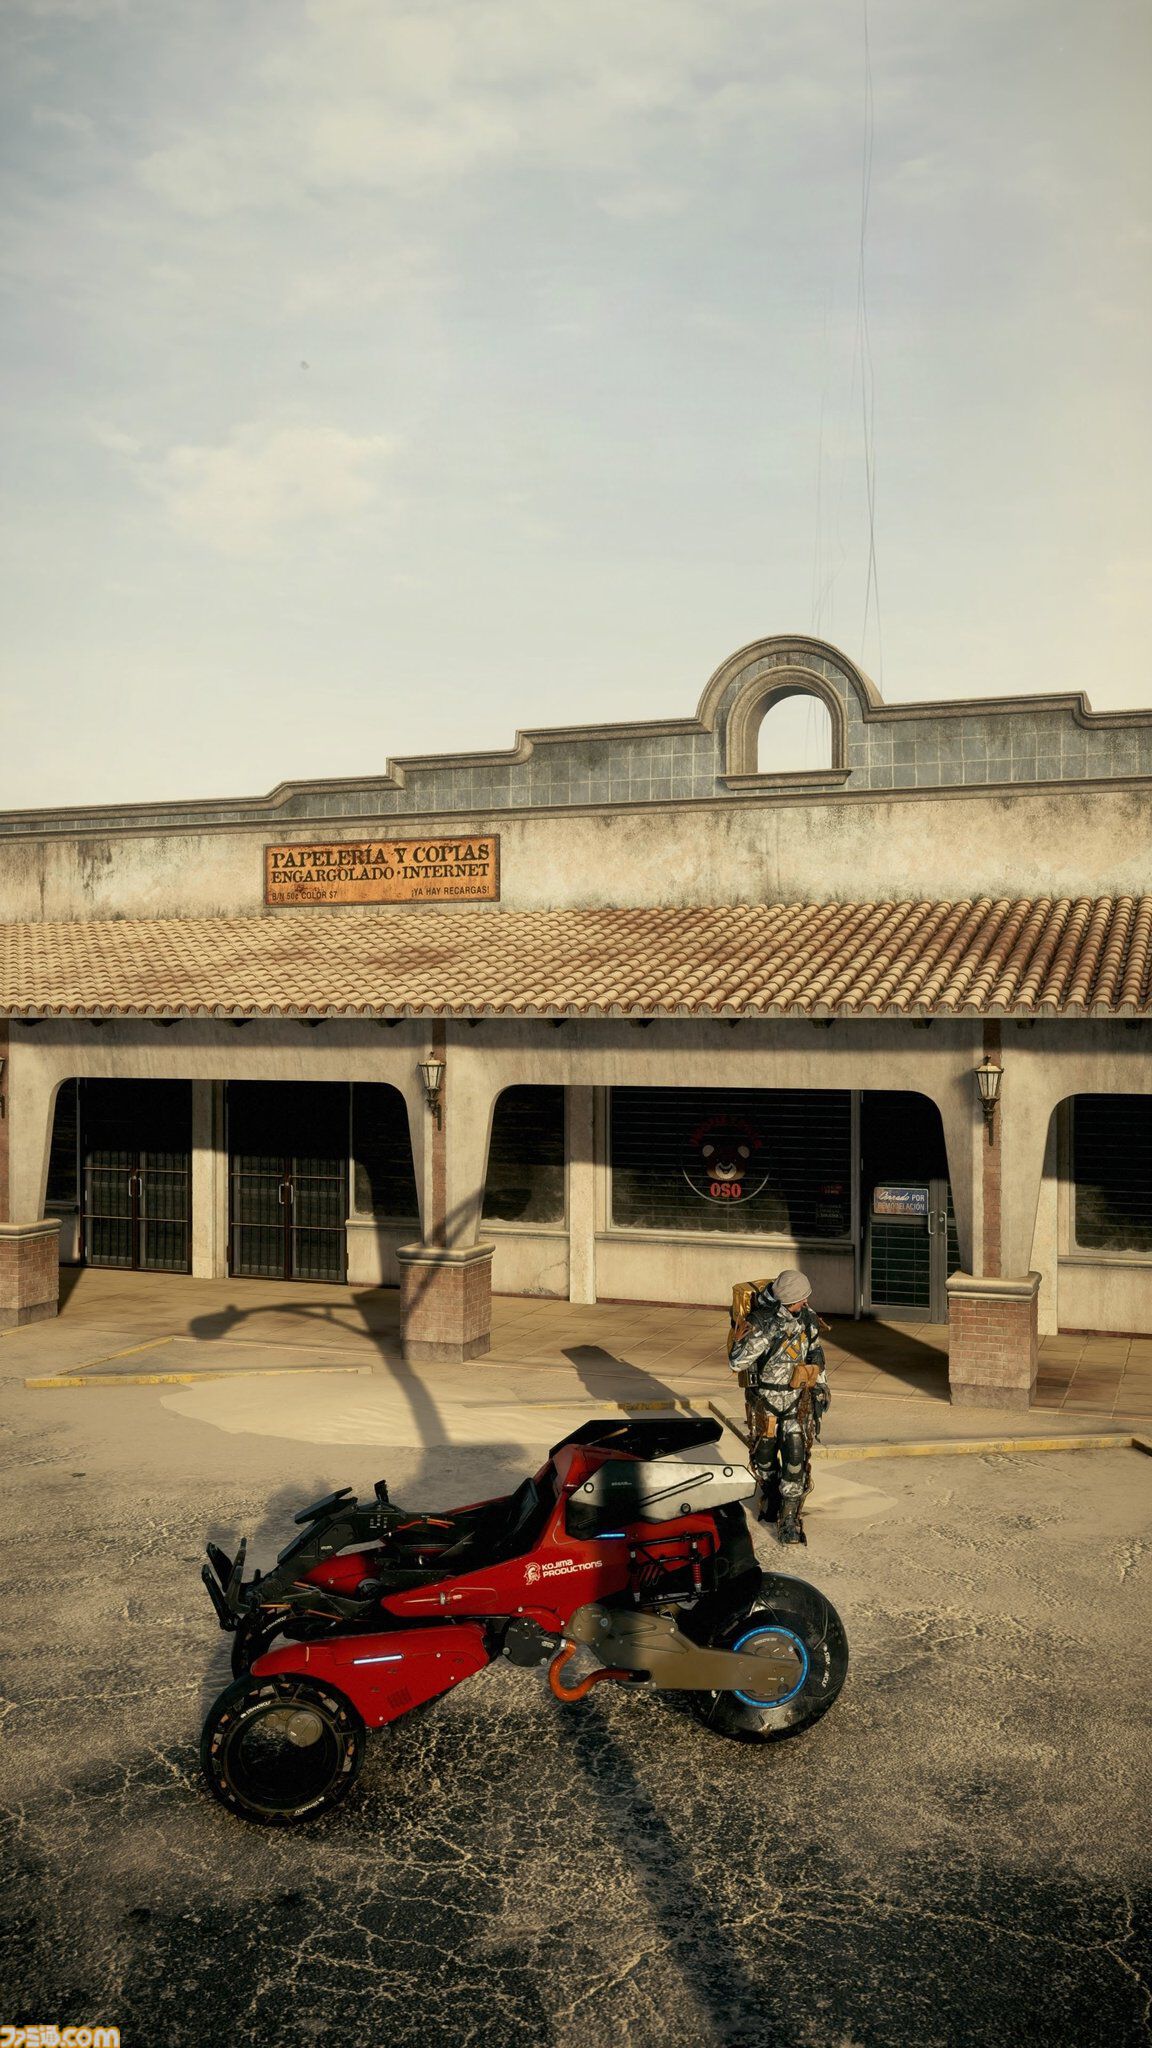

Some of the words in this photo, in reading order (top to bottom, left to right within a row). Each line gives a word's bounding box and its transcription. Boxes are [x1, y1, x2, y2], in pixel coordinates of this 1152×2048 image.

[271, 844, 389, 868] PAPELERÍA
[394, 847, 407, 863] Y
[412, 843, 490, 863] COPIAS
[271, 866, 395, 884] ENGARGOLADO
[402, 863, 490, 879] INTERNET
[301, 890, 327, 900] COLOR
[426, 887, 441, 896] HAY
[444, 885, 490, 896] RECARGAS!
[710, 1182, 742, 1198] OSO
[911, 1194, 925, 1202] POR
